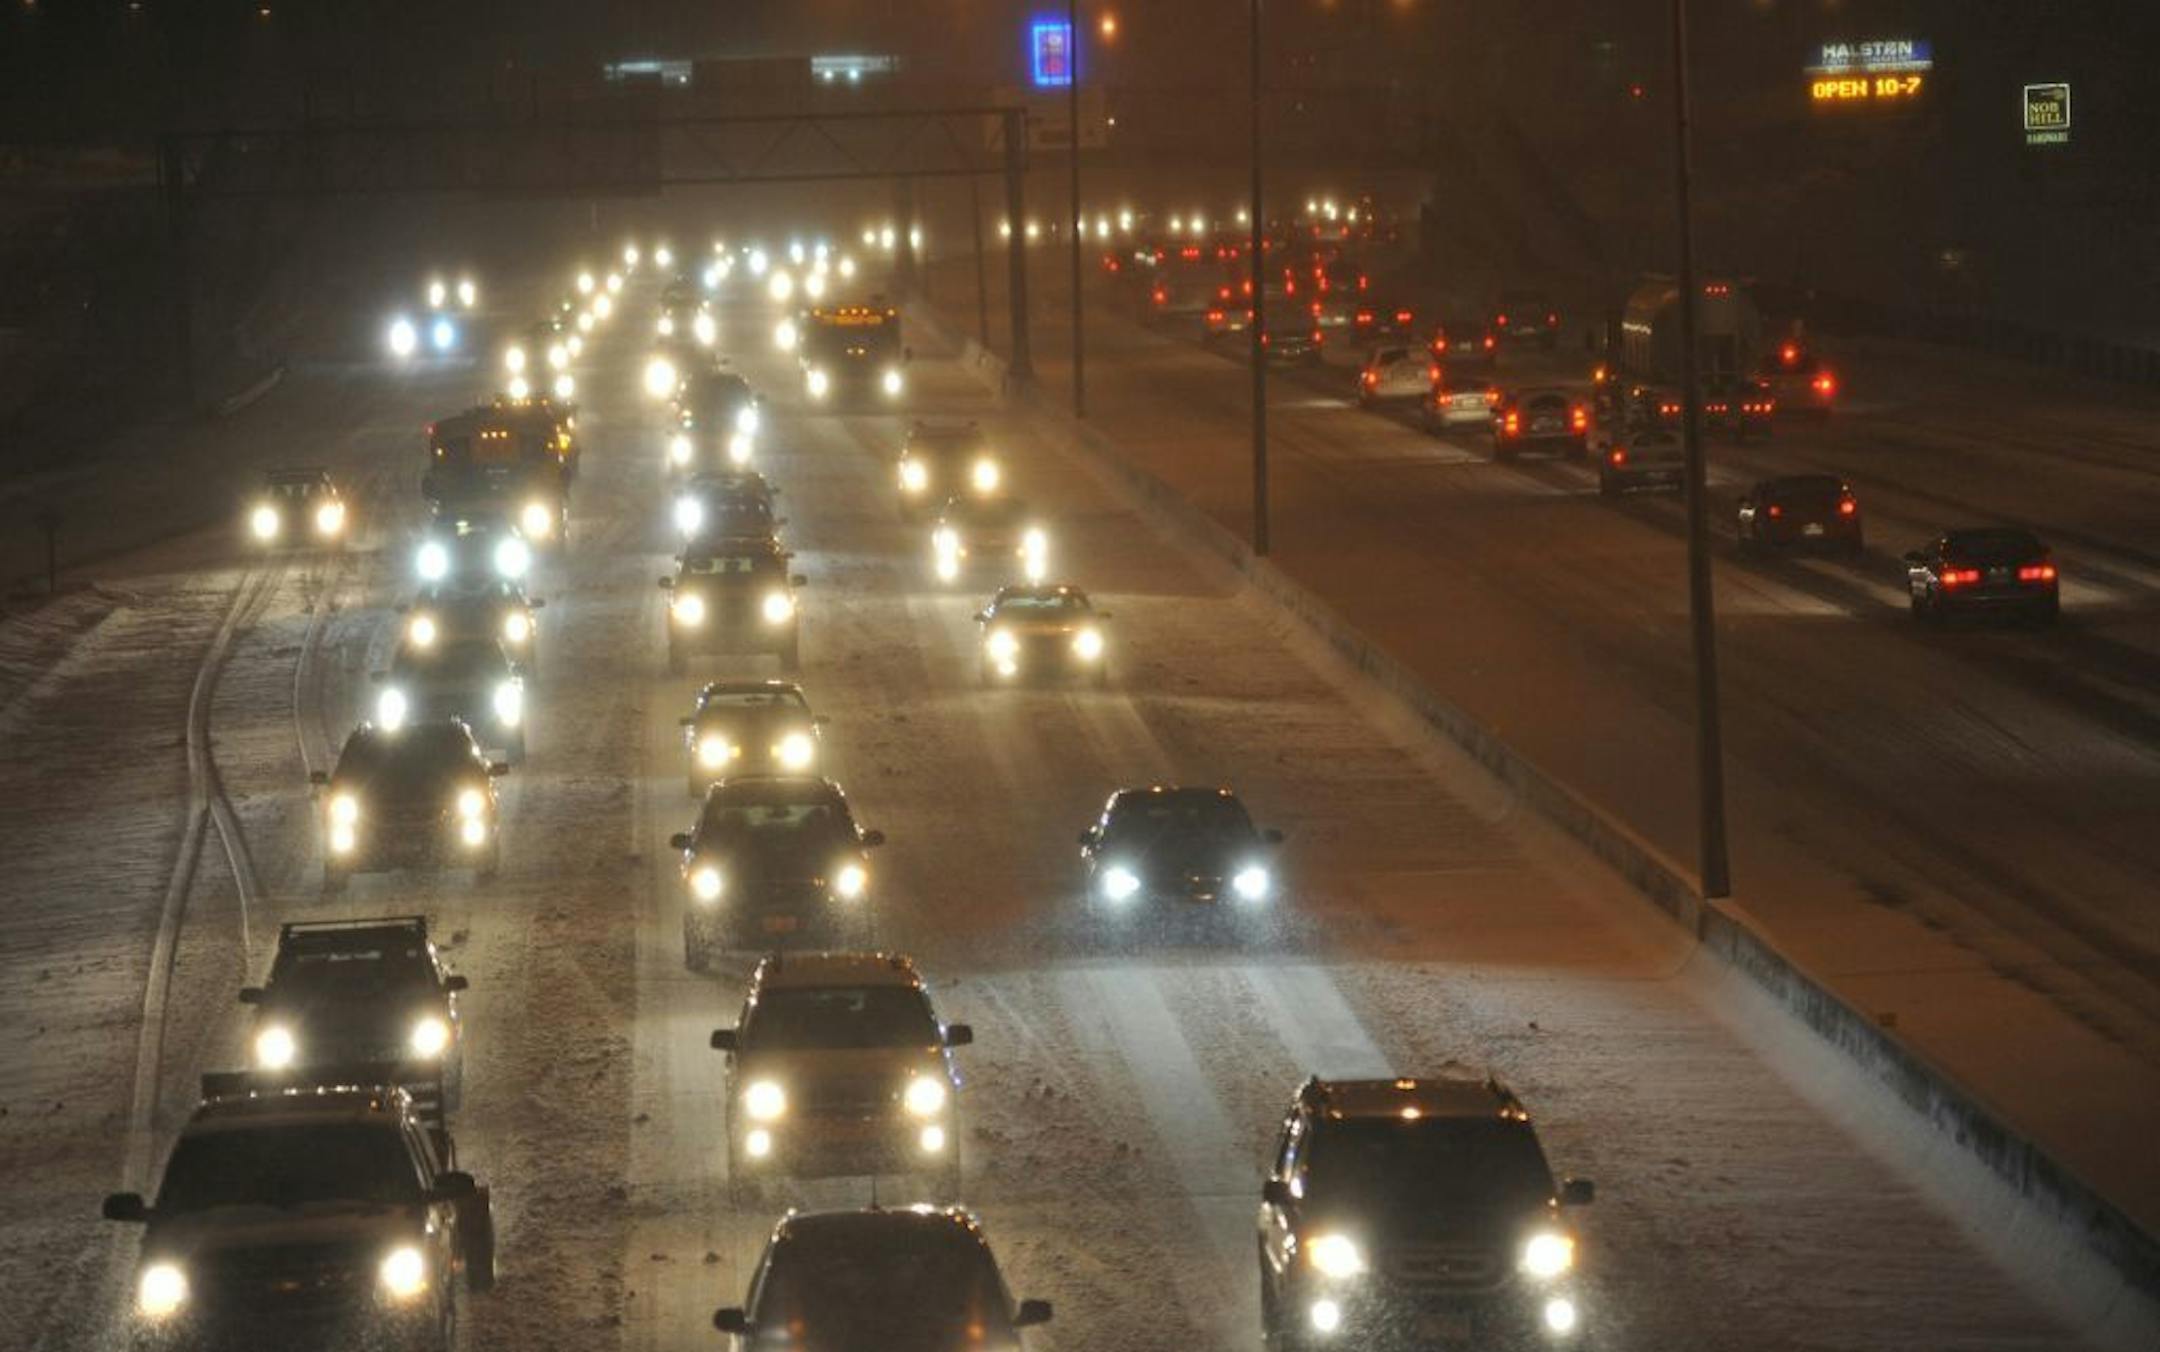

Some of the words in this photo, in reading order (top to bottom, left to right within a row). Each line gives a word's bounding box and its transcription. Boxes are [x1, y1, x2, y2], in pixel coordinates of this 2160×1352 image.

[1812, 81, 1868, 99] OPEN
[1876, 76, 1922, 96] 10-7
[2029, 102, 2060, 113] NOB
[2029, 113, 2064, 125] HILL
